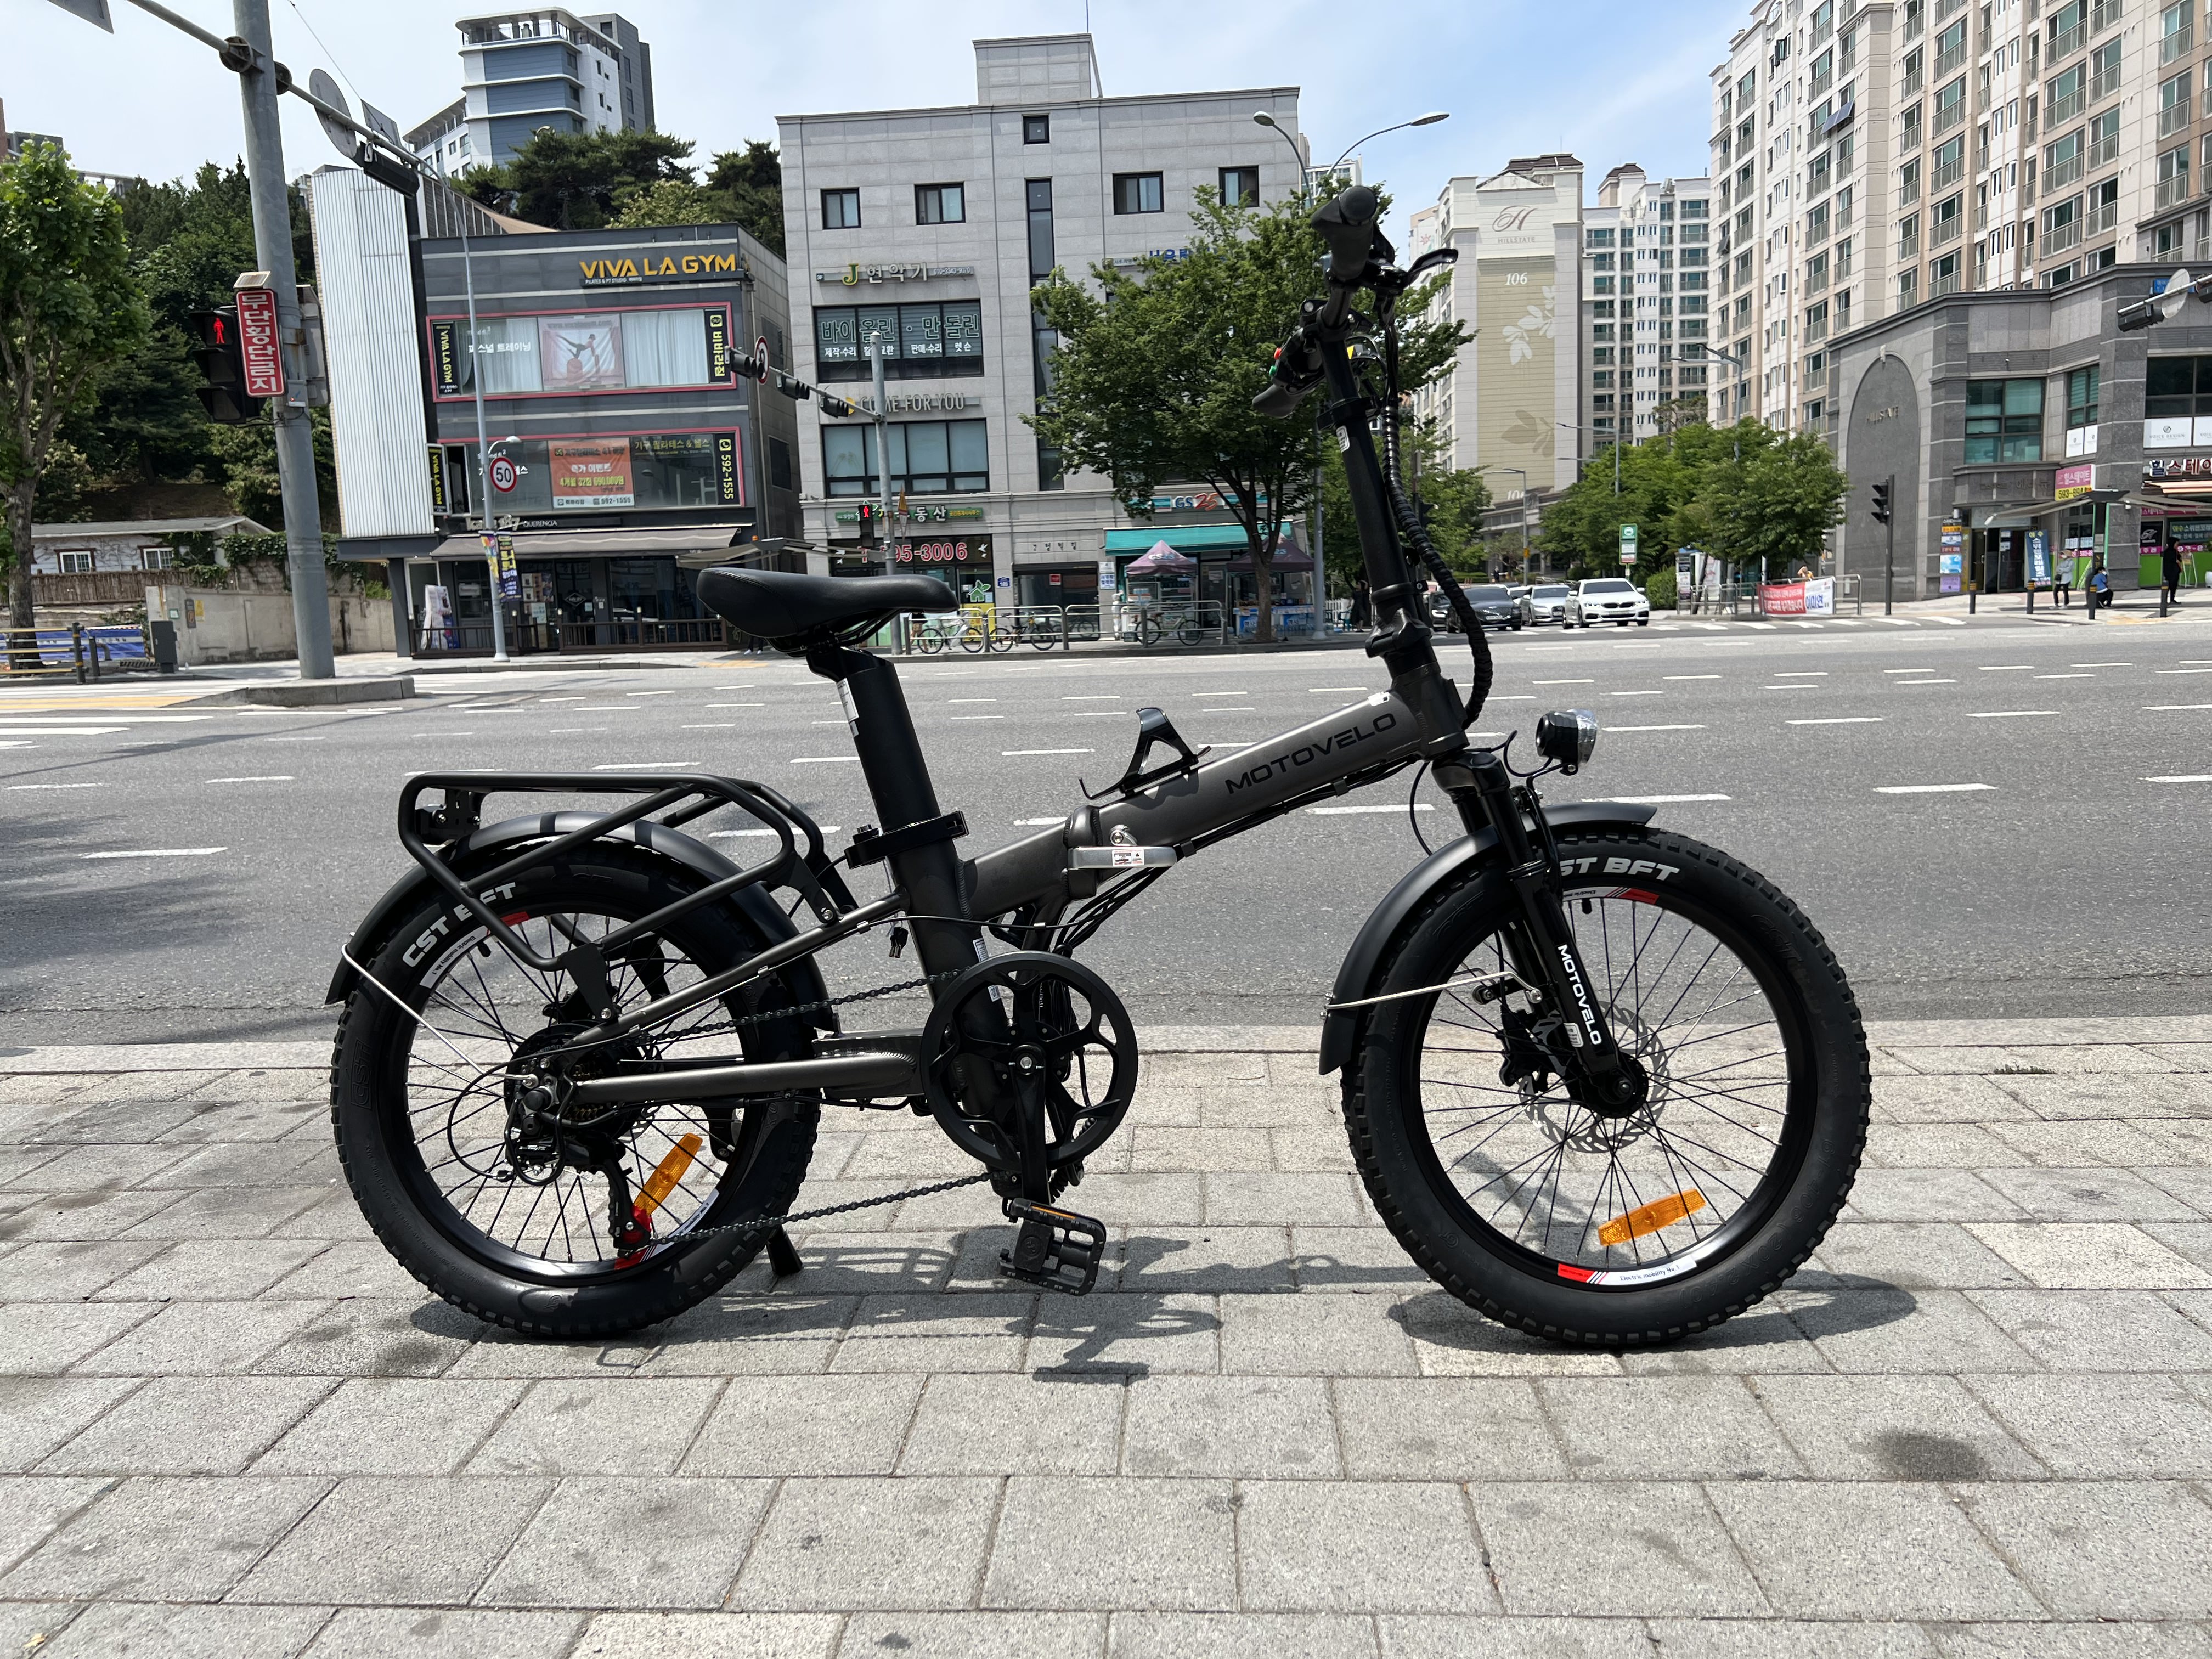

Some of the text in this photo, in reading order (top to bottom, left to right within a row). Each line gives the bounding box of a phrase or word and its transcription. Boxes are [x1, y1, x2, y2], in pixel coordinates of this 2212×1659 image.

[579, 253, 736, 278] VIVA LA GYM
[842, 263, 860, 286] J
[1505, 272, 1528, 285] 106
[821, 314, 980, 343] 바이올린 만돌린
[242, 294, 277, 391] 무단횡단금지
[441, 330, 449, 351] VIVA
[497, 342, 531, 352] 트레이닝
[442, 351, 451, 363] LA
[712, 331, 725, 377] 비바라짐
[443, 364, 453, 383] GYM
[905, 394, 932, 412] FOR
[935, 393, 965, 410] YOU
[635, 440, 651, 450] 기구
[653, 439, 685, 450] 필라테스
[496, 467, 511, 483] 50
[588, 462, 612, 472] 이벤트
[721, 454, 735, 500] 592-1555
[600, 496, 631, 505] 592-1555
[1175, 492, 1219, 511] GS25
[1225, 713, 1397, 794] MOTOVELO
[1560, 857, 1680, 881] ST BFT
[402, 915, 450, 968] CST
[456, 935, 476, 950] Electric
[439, 947, 459, 967] mobility
[1558, 944, 1602, 1045] MOTOVELO
[1643, 1270, 1666, 1280] mobility
[1666, 1265, 1680, 1274] No.1
